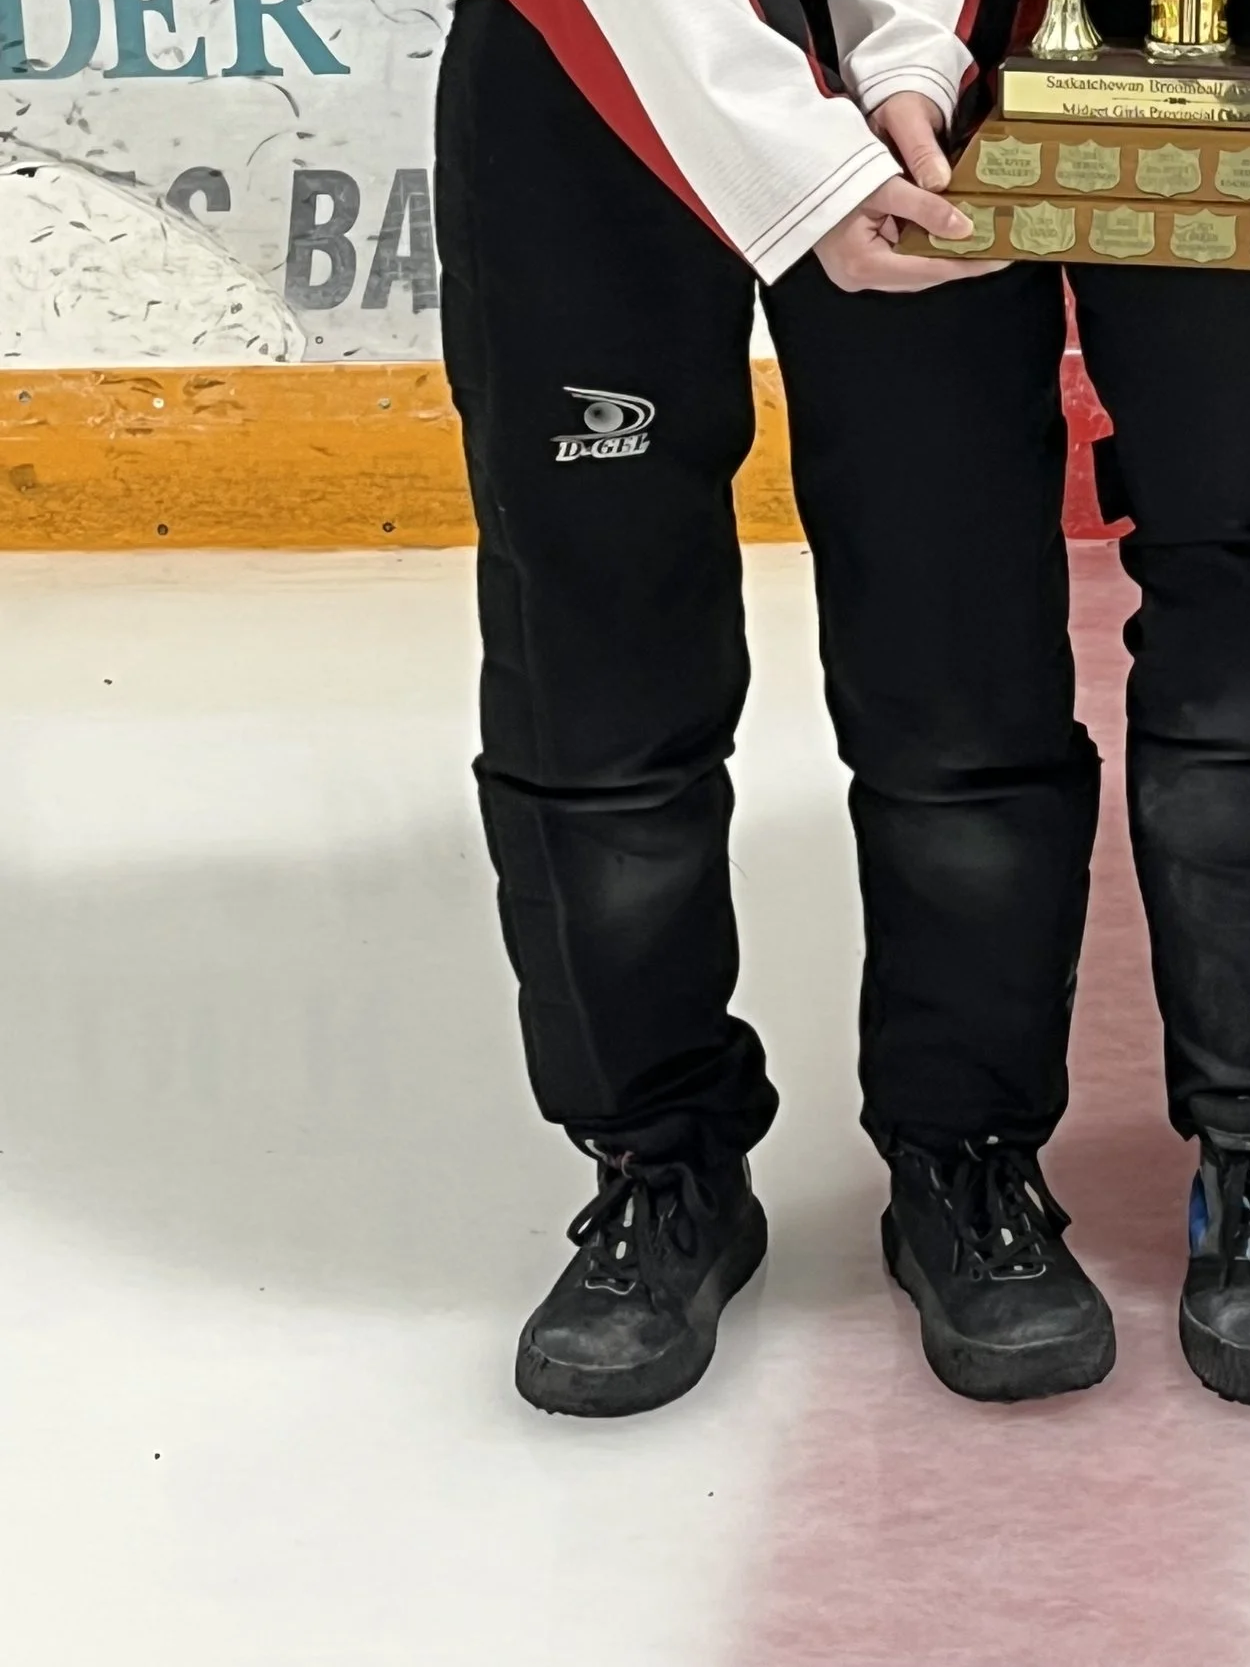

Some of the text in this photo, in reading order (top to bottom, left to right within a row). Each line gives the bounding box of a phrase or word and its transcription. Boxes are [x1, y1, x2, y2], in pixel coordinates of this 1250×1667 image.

[1046, 75, 1144, 92] Saskatchewan
[1149, 79, 1223, 96] Broomball
[1062, 102, 1109, 118] Midget
[1112, 105, 1145, 119] Girls
[1149, 106, 1215, 121] Provincial
